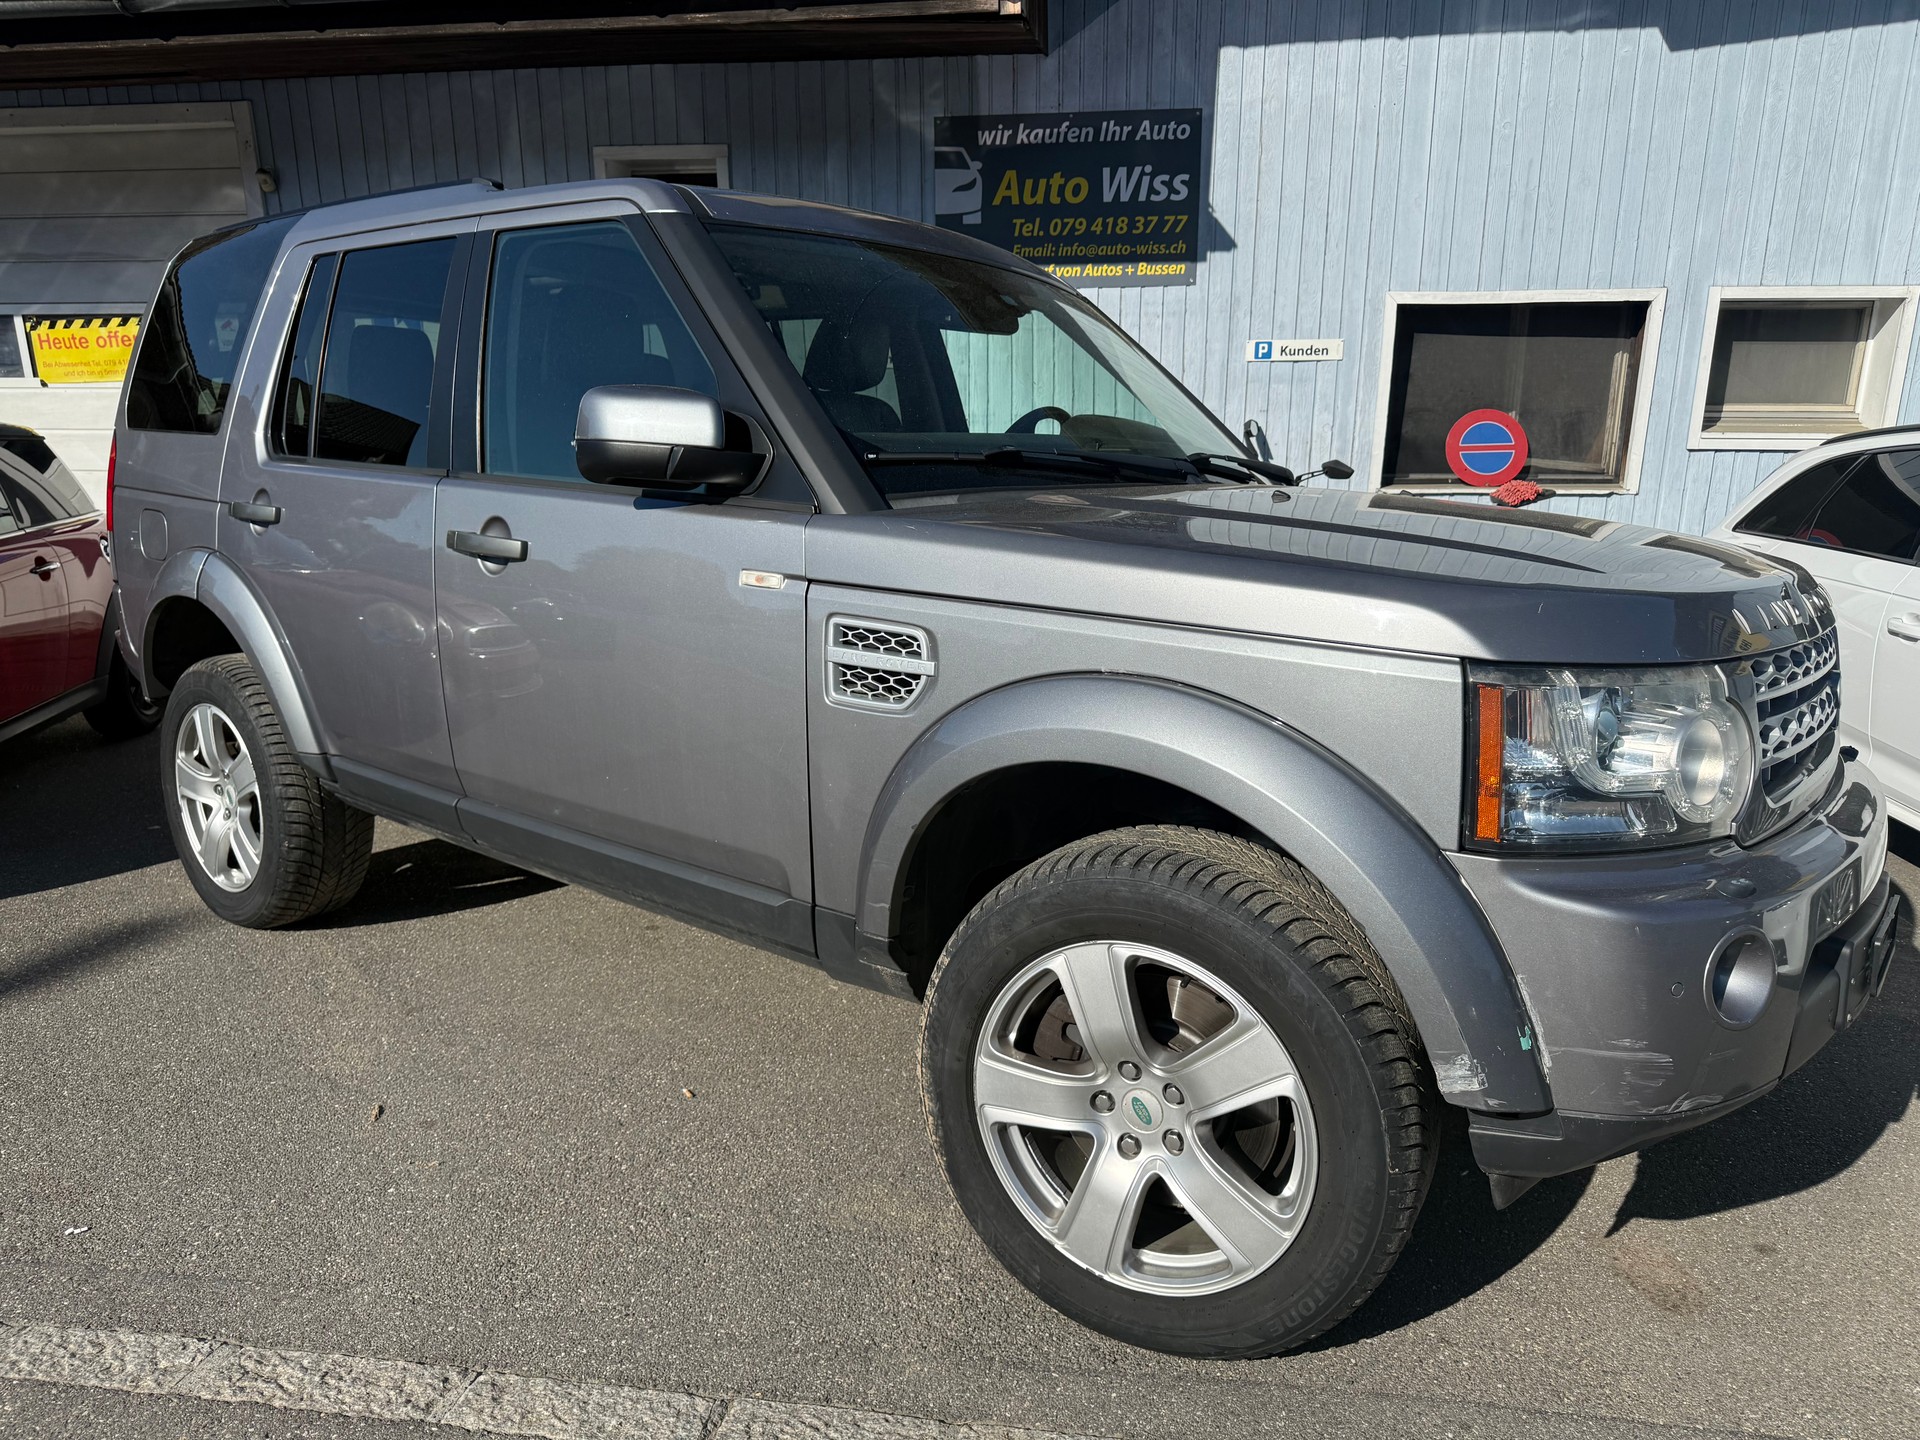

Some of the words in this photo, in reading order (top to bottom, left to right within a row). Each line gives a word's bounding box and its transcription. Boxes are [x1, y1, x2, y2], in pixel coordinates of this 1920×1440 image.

[977, 124, 1012, 146] wir
[1016, 121, 1094, 145] kaufen
[1099, 120, 1132, 142] Ihr
[1135, 120, 1191, 141] Auto
[992, 169, 1089, 206] Auto
[1102, 164, 1190, 203] Wiss
[1012, 218, 1044, 237] Tel.
[1050, 217, 1087, 236] 079
[1091, 216, 1128, 235] 418
[1133, 216, 1158, 235] 37
[1162, 215, 1189, 233] 77
[1012, 243, 1055, 258] Email:
[1058, 240, 1186, 257] info@auto-wiss.ch
[1056, 267, 1081, 278] von
[1083, 263, 1123, 277] Autos
[1125, 265, 1135, 275] +
[1137, 262, 1186, 276] Bussen
[37, 333, 90, 350] Heute
[96, 330, 137, 348] offe
[1280, 345, 1329, 356] Kunden
